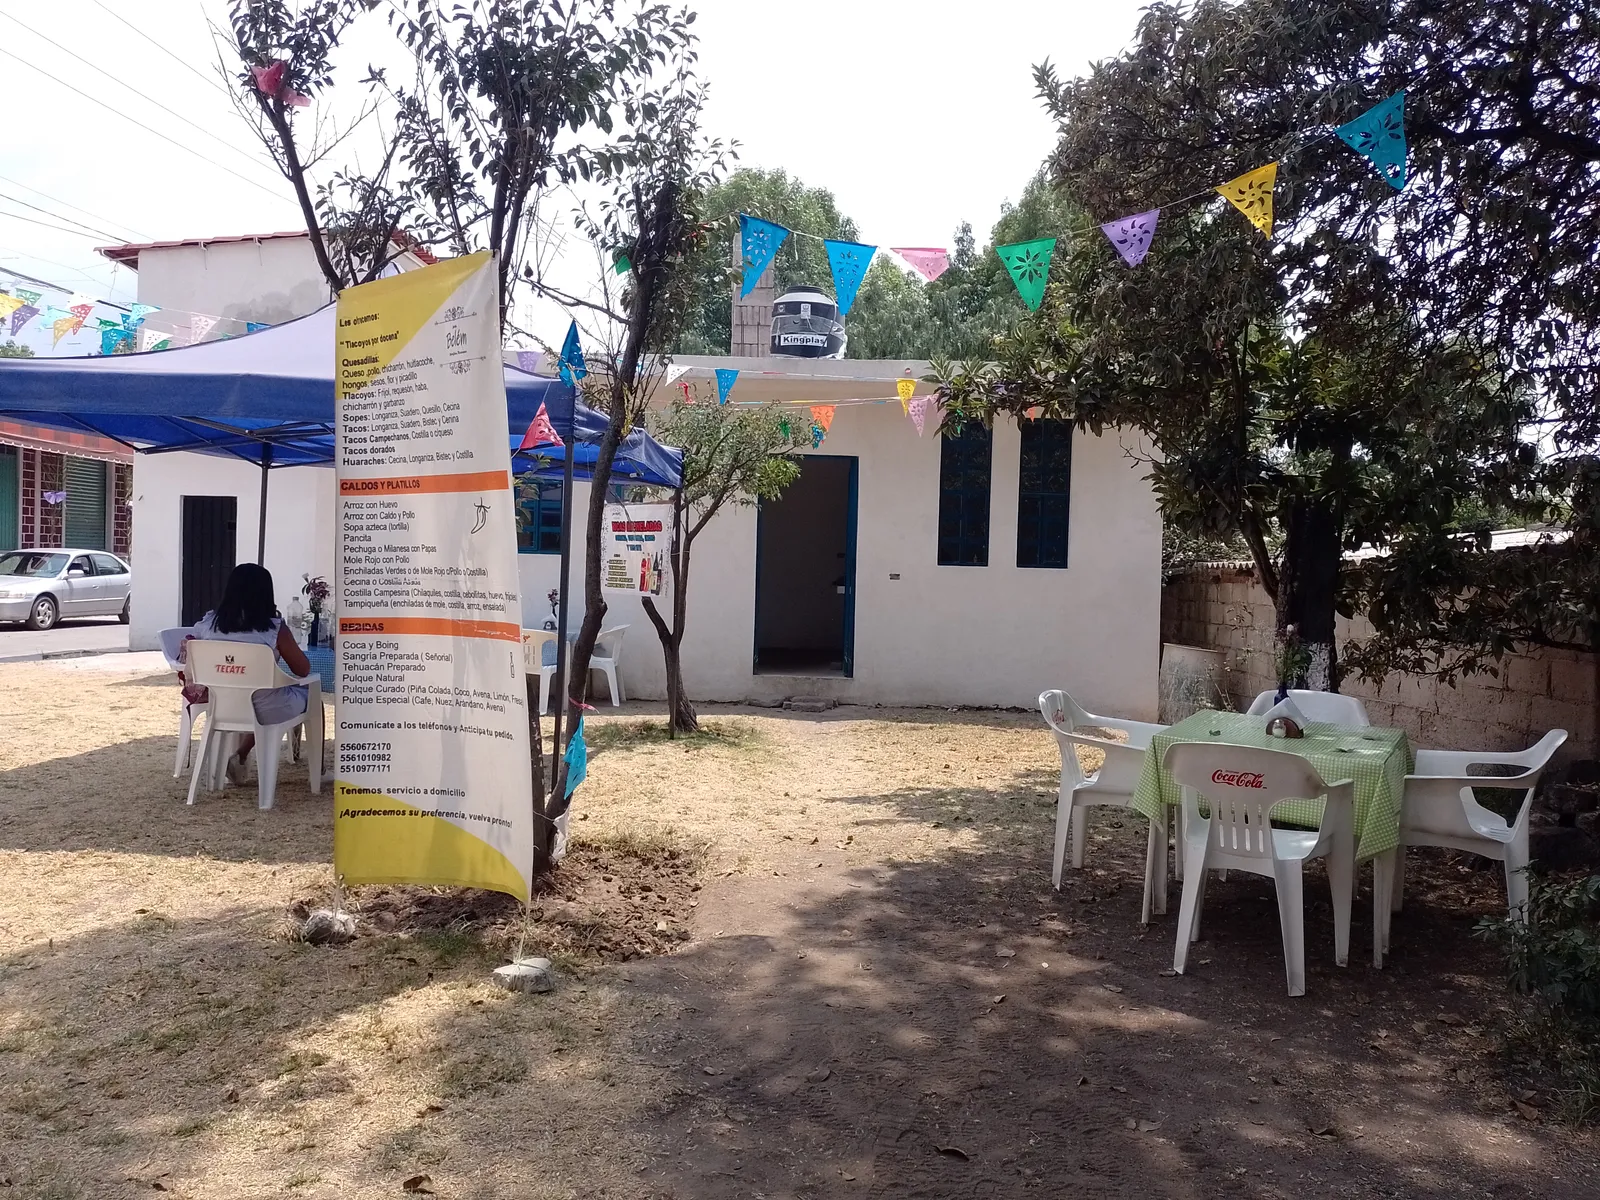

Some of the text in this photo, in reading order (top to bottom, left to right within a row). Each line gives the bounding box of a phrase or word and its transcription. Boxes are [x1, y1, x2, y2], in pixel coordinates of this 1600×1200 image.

[340, 319, 351, 327] Les
[380, 330, 399, 342] docena"
[342, 356, 379, 367] Quesadillas:
[342, 369, 364, 378] Queso
[342, 381, 369, 390] hongos,
[387, 376, 395, 384] flor
[399, 372, 418, 384] picadillo
[342, 392, 376, 400] Tlacoyos:
[342, 398, 406, 411] chicharrón y garbanzo
[342, 402, 460, 423] Sopes: Longaniza, Suadero, Quesillo, Cecina
[342, 425, 370, 433] Tacos:
[371, 422, 400, 432] Longaniza,
[400, 420, 422, 429] Suadero,
[422, 418, 437, 426] Bistec
[342, 436, 368, 444] Tacos
[369, 432, 411, 444] Campechanos,
[411, 430, 429, 440] Costilla
[342, 446, 396, 455] Tacos dorados
[342, 450, 474, 466] Huaraches: Cecina, Longaniza, Bistec y Costilla
[341, 480, 420, 490] CALDOS Y PLATILLOS
[344, 501, 364, 509] Arroz
[380, 500, 398, 509] Huevo
[344, 512, 364, 520] Arroz
[380, 512, 397, 520] Caldo
[398, 513, 402, 521] y
[402, 510, 416, 519] Pollo
[344, 522, 410, 532] Sopa azteca (tortilla)
[344, 534, 372, 542] Pancita
[344, 545, 376, 554] Pechuga
[384, 544, 410, 553] Milanesa
[422, 544, 437, 554] Papas
[344, 556, 363, 564] Mole
[364, 556, 381, 565] Rojo
[396, 555, 410, 564] Pollo
[344, 566, 384, 575] Enchiladas
[385, 566, 406, 575] Verdes
[413, 567, 420, 575] de
[420, 566, 433, 575] Mole
[434, 567, 446, 577] Rojo
[344, 578, 371, 586] Cecina
[344, 588, 372, 597] Costilla
[374, 588, 410, 598] Campesina
[411, 588, 443, 599] (Chilaquiles,
[444, 589, 463, 599] costilla,
[344, 600, 388, 609] Tampiqueña
[390, 600, 424, 610] (enchiladas
[432, 601, 447, 610] mole,
[448, 602, 466, 611] costilla,
[482, 602, 507, 614] ensalada)
[341, 622, 384, 632] BEBIDAS
[342, 641, 366, 650] Coca
[376, 640, 398, 650] Boing
[380, 652, 418, 662] Preparada
[216, 664, 246, 674] TECATE
[342, 663, 426, 672] Tehuacán Preparado
[342, 674, 404, 683] Pulque Natural
[342, 685, 374, 694] Pulque
[376, 684, 406, 693] Curado
[407, 685, 426, 695] (Piña
[428, 686, 453, 696] Colada,
[454, 687, 472, 698] Coco,
[472, 689, 492, 700] Avena,
[493, 690, 511, 703] Limón,
[342, 696, 374, 705] Pulque
[376, 696, 410, 706] Especial
[486, 702, 506, 714] Avena)
[404, 721, 416, 729] los
[418, 721, 452, 730] teléfonos
[453, 725, 458, 733] y
[460, 724, 486, 736] Anticipa
[486, 728, 493, 736] tu
[494, 730, 514, 740] pedido.
[340, 742, 392, 751] 5560672170
[340, 754, 392, 762] 5561010982
[340, 764, 391, 773] 5510977171
[1212, 769, 1264, 788] Coca-Cola
[340, 786, 382, 795] Tenemos
[386, 786, 421, 795] servicio
[430, 788, 466, 797] domicilio
[340, 808, 406, 818] ¡Agradecemos
[421, 809, 467, 820] preferencia,
[468, 814, 490, 822] vuelva
[492, 817, 512, 828] pronto!
